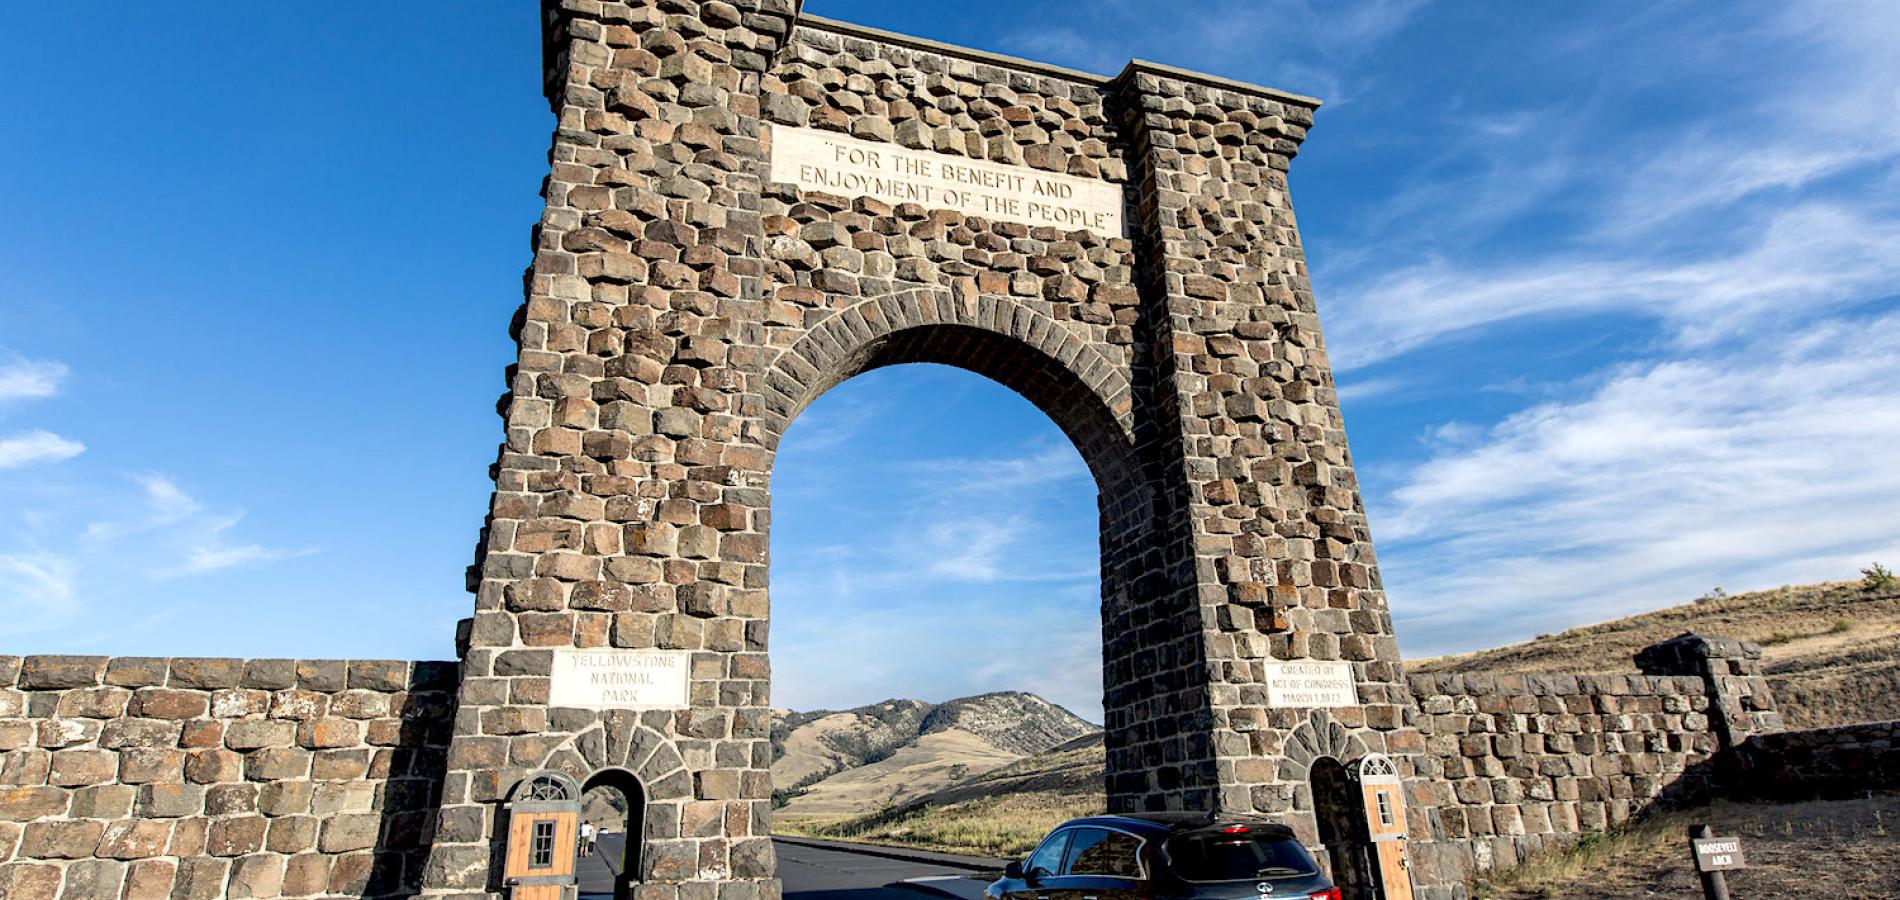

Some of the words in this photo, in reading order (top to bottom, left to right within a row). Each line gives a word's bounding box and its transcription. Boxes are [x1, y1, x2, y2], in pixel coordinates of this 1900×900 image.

[893, 155, 932, 178] THE
[941, 163, 1025, 193] BENEFIT
[1032, 178, 1073, 200] AND
[800, 164, 933, 203] ENJOYMENT
[943, 188, 970, 209] OF
[980, 194, 1020, 217] THE
[572, 655, 675, 668] YELLOWSTONE
[1280, 665, 1321, 675] CREATED
[591, 672, 654, 685] NATIONAL
[602, 690, 638, 702] PARK
